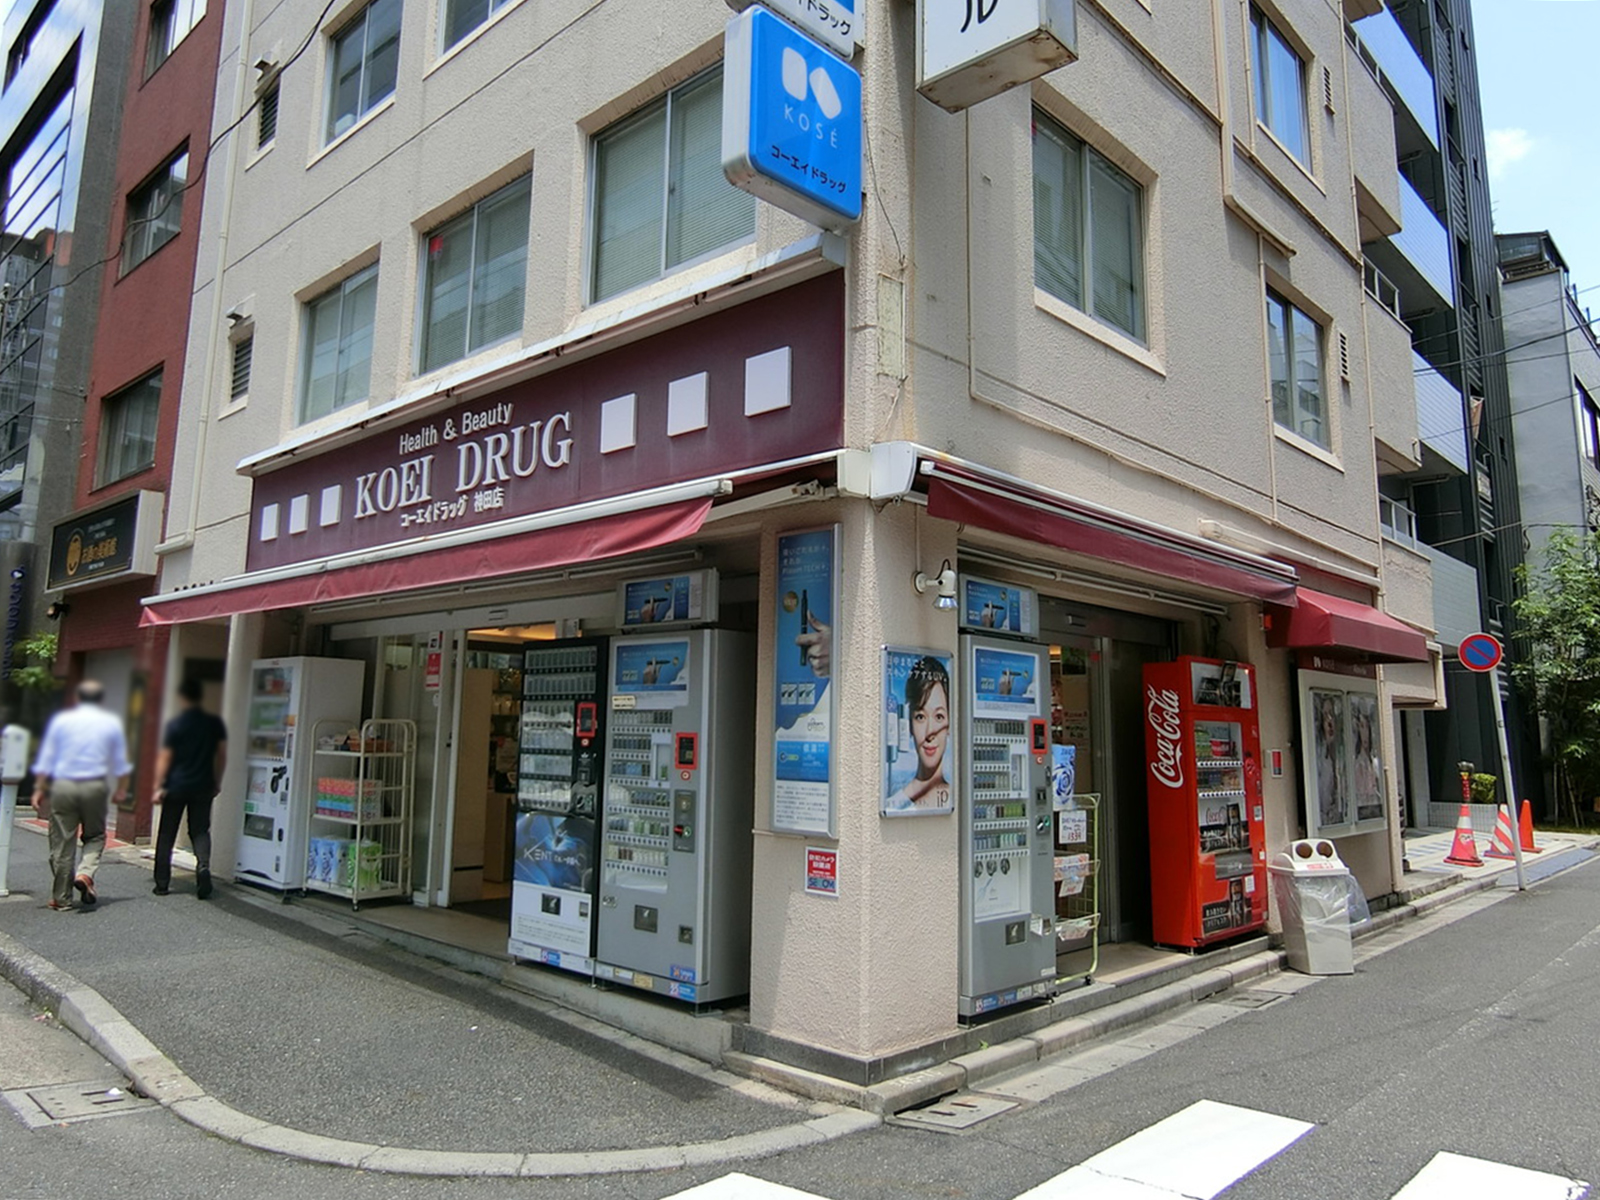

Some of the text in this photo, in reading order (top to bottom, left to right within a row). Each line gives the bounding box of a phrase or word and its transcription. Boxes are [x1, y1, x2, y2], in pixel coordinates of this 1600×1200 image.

[784, 103, 838, 149] KOSÉ
[771, 145, 847, 193] コーエイドラッグ
[399, 402, 513, 455] Health & Beauty
[354, 411, 573, 519] KOEI DRUG
[401, 486, 505, 527] コーエイドラッグ 神田店
